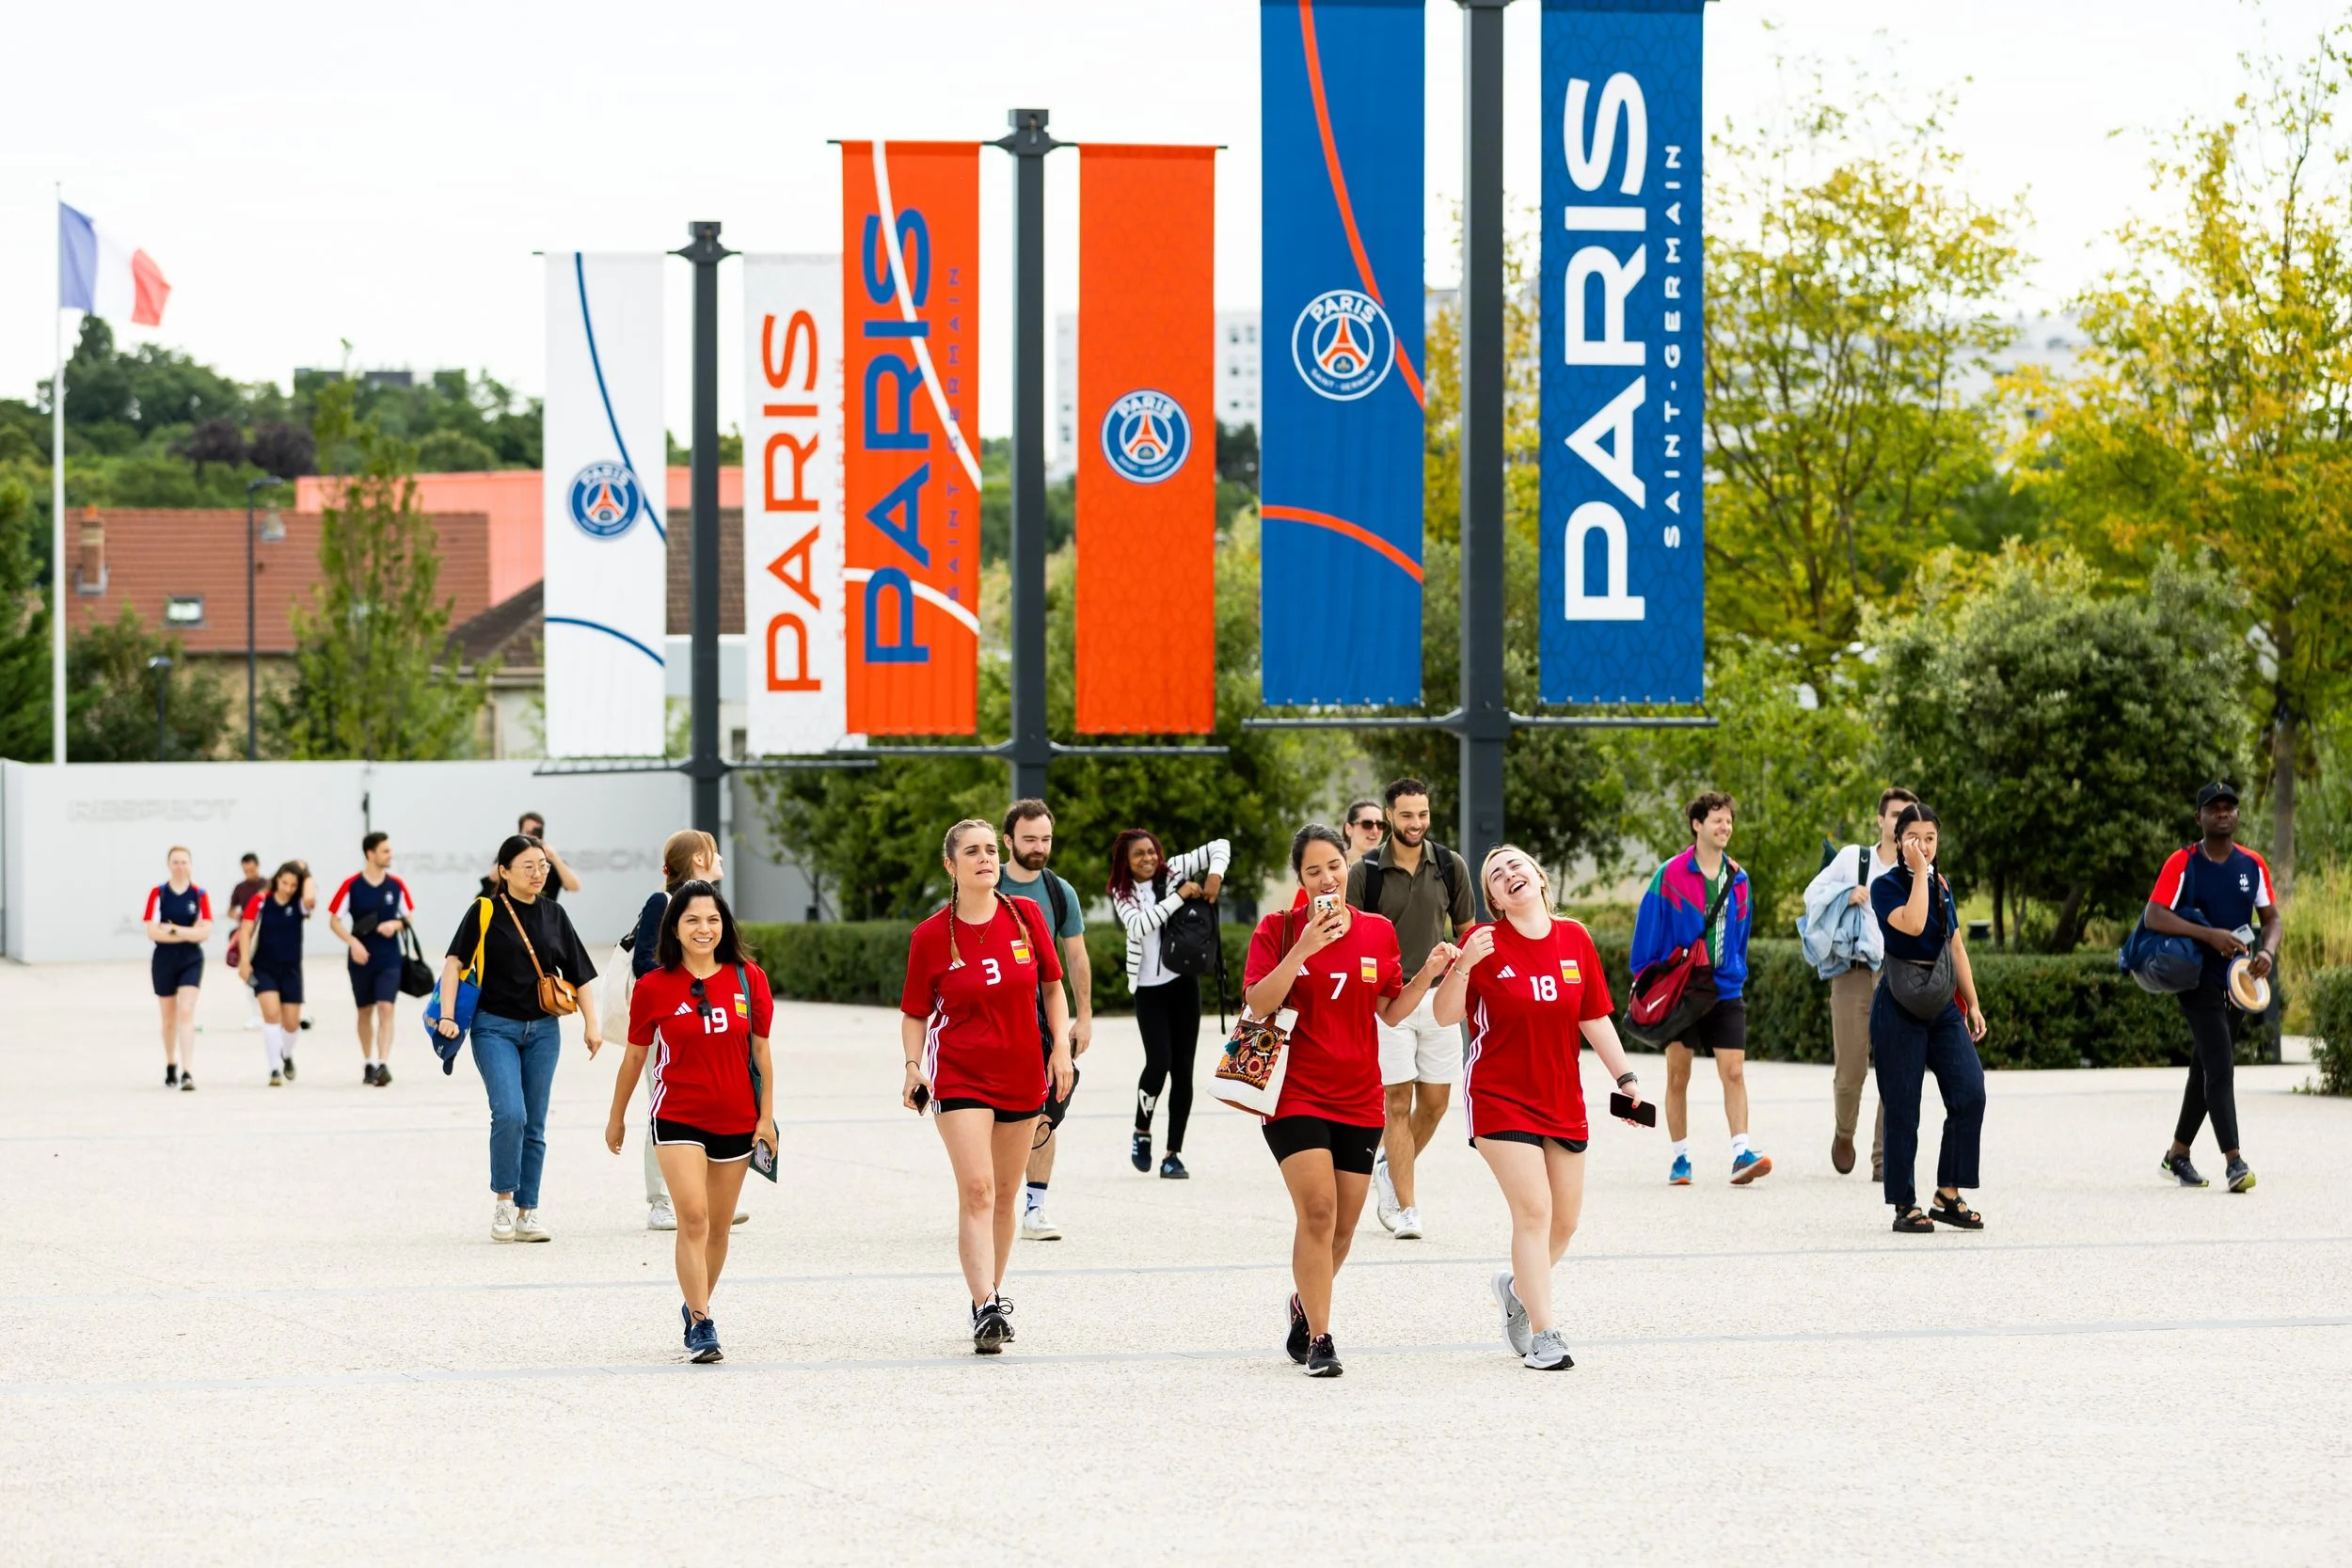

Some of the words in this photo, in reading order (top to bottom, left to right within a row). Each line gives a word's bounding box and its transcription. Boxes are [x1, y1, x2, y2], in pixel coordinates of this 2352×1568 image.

[1309, 295, 1376, 324] PARIS
[1563, 71, 1647, 621] PARIS
[1663, 145, 1681, 548] SAINT-GERMAIN
[1116, 395, 1175, 420] PARIS
[862, 208, 931, 663] PARIS
[761, 309, 822, 692] PARIS
[981, 958, 1002, 986] 3
[1329, 972, 1348, 1000] 7
[1529, 974, 1558, 1002] 18
[703, 1006, 729, 1035] 19
